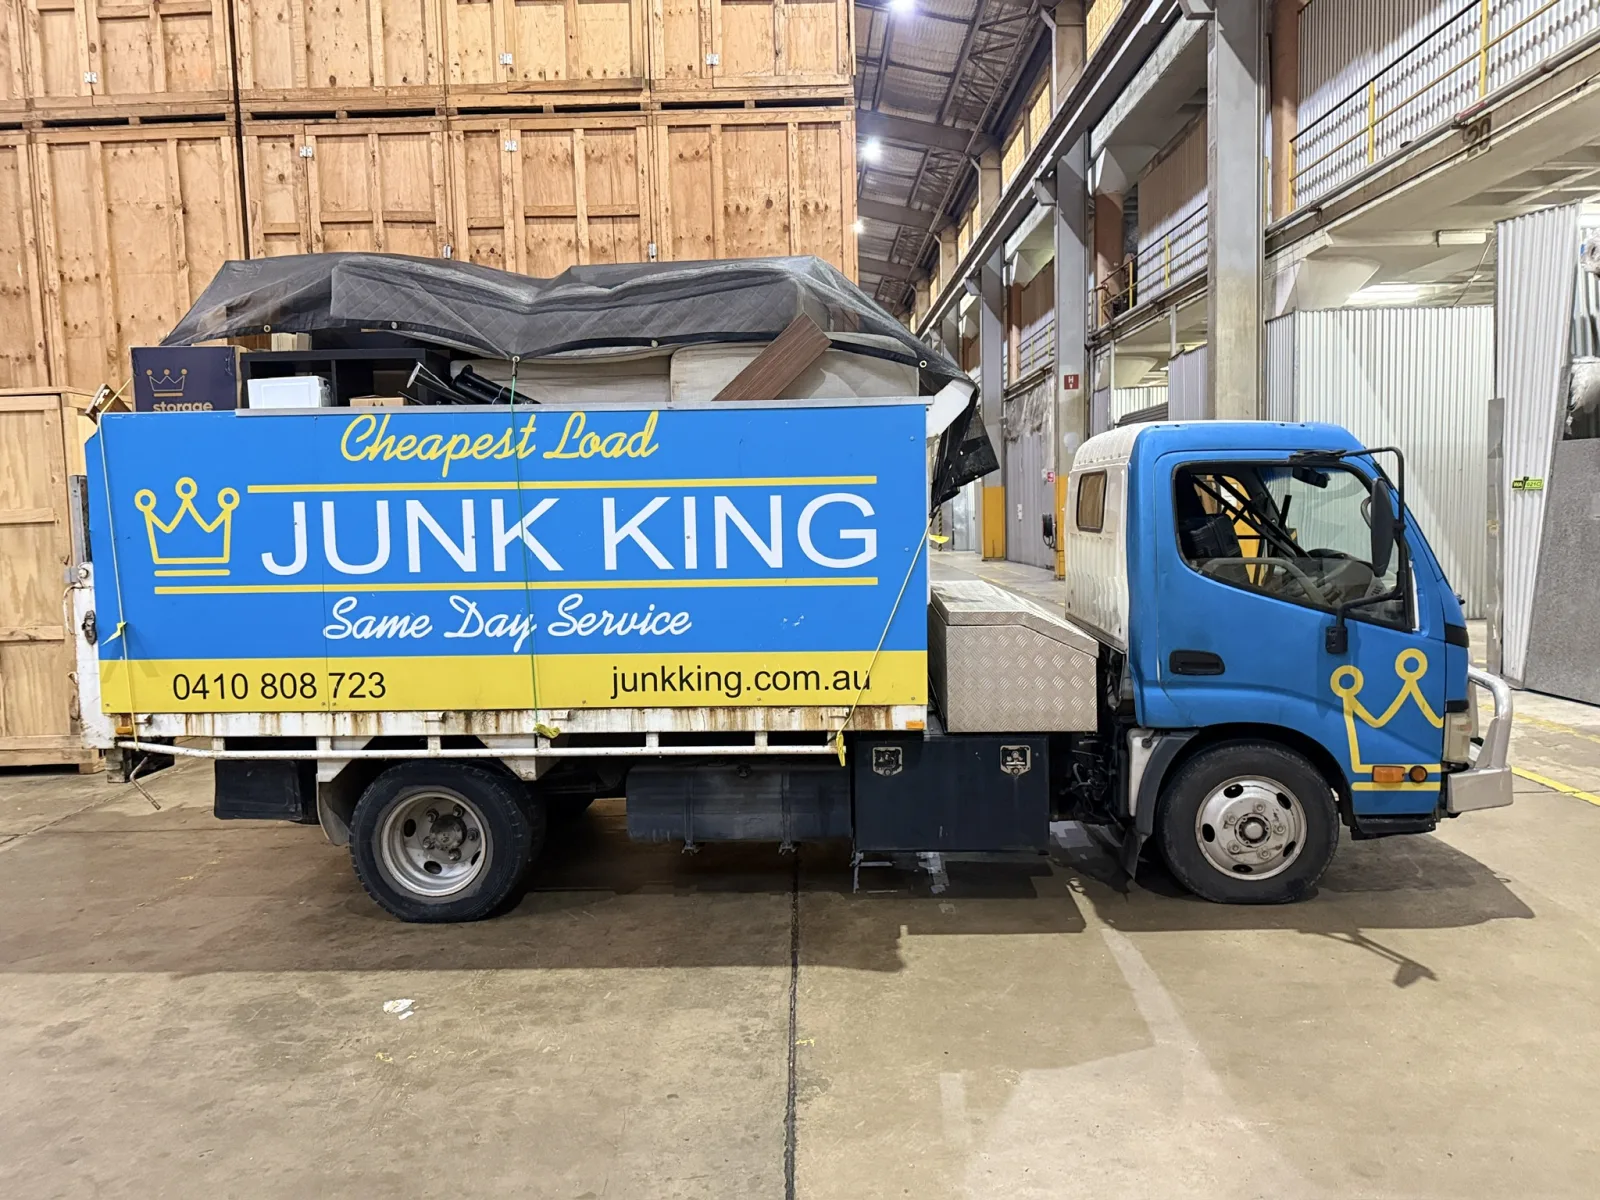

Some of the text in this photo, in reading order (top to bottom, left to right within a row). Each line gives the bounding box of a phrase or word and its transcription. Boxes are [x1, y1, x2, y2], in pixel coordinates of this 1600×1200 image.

[153, 402, 213, 412] storage
[341, 411, 660, 477] Cheapest Load
[261, 492, 877, 576] JUNK KING
[322, 593, 693, 653] Same Day Service
[172, 665, 871, 701] 0410 808 723 junkking.com.au
